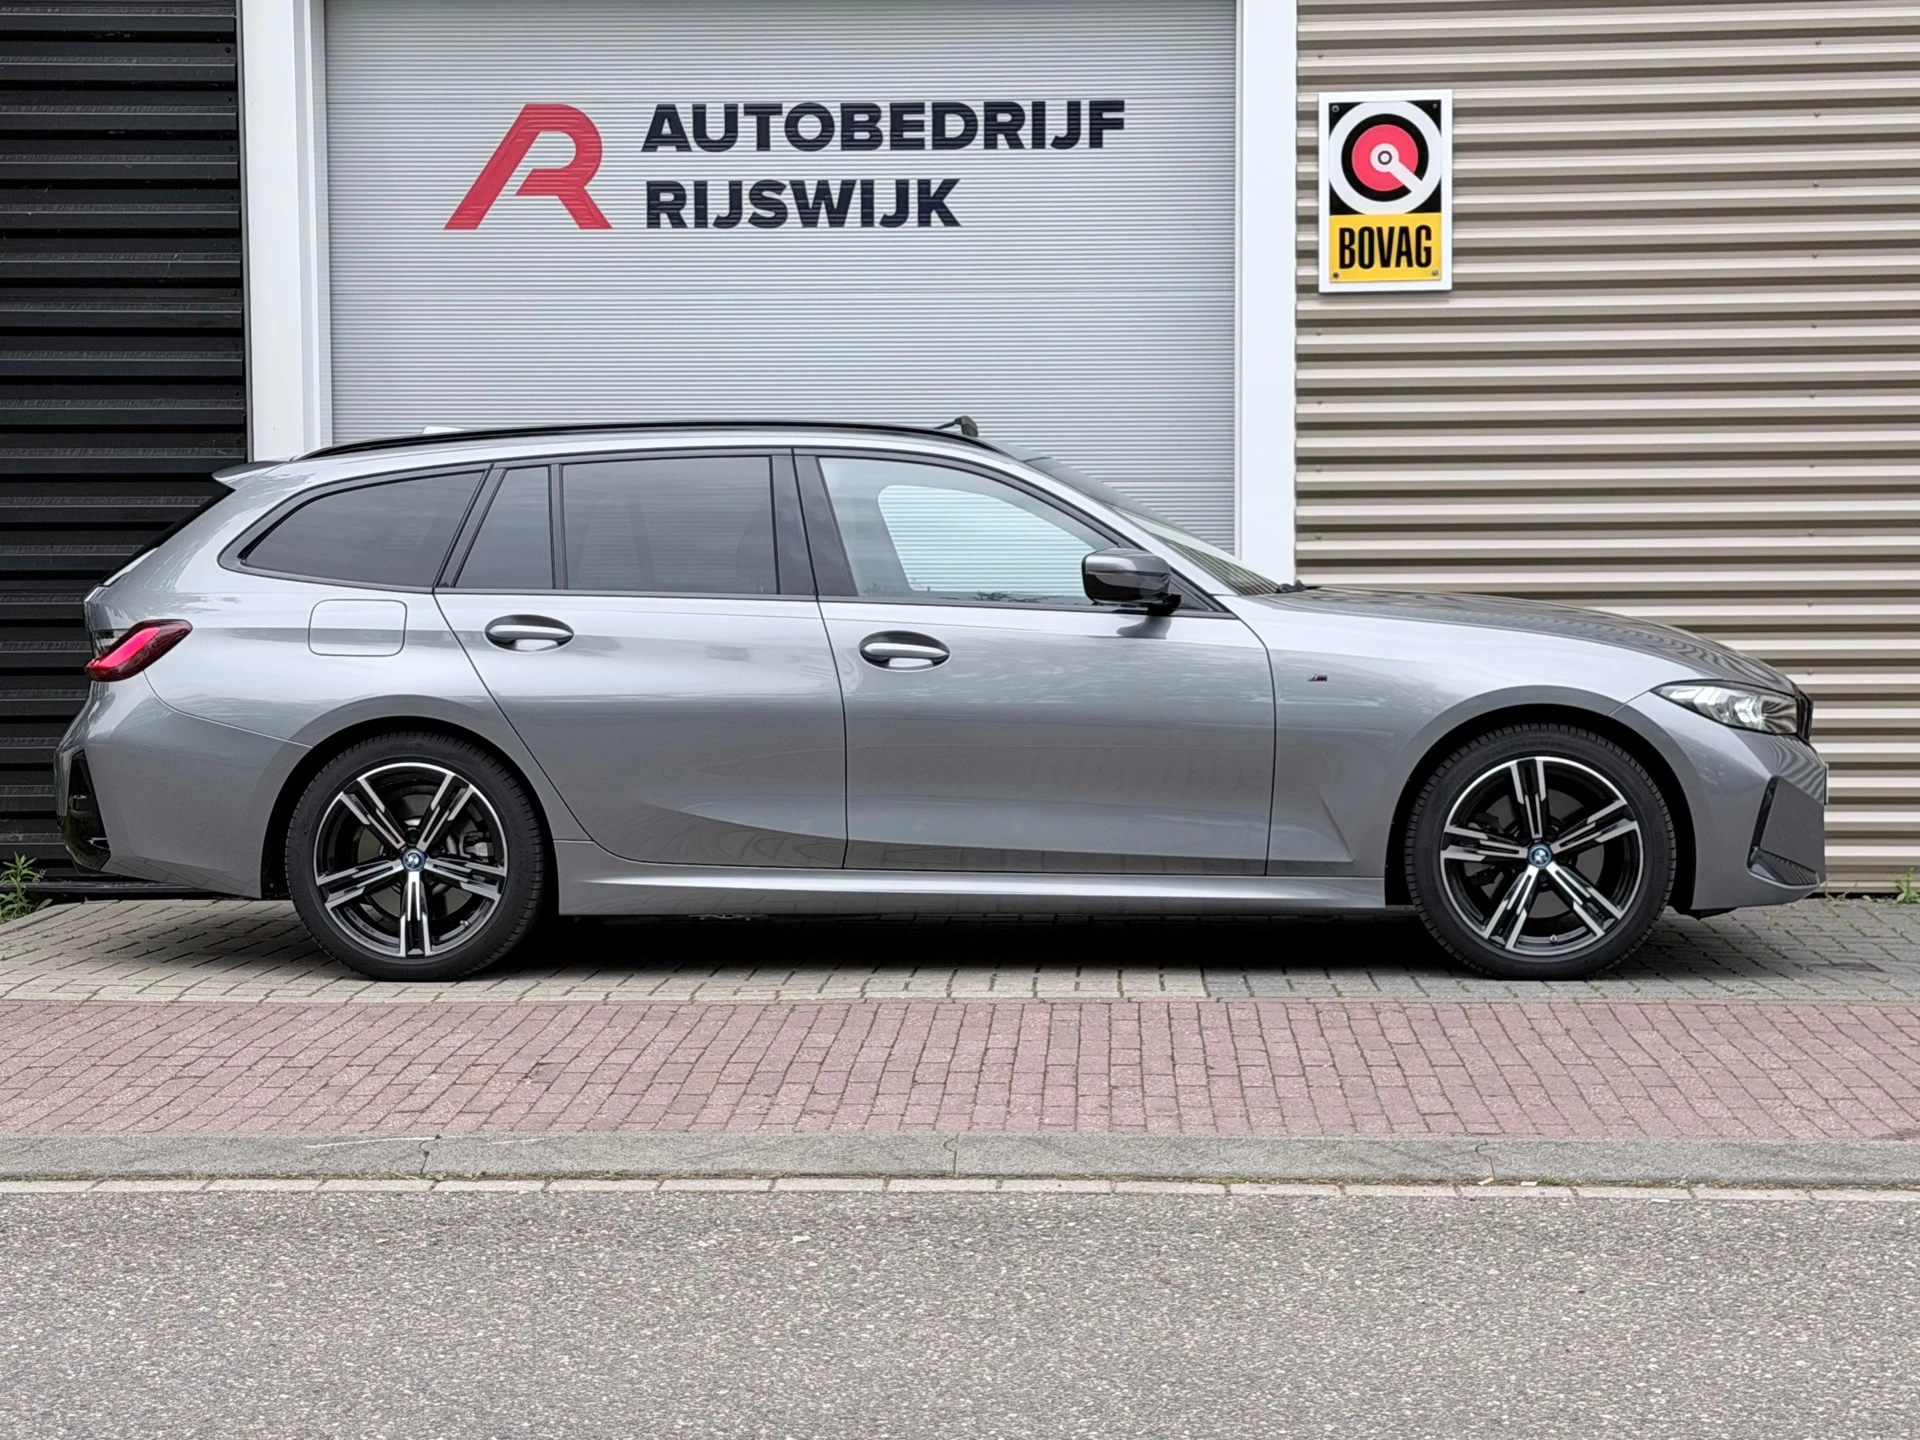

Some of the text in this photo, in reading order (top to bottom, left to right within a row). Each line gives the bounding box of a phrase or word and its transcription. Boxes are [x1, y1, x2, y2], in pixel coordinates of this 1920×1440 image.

[642, 100, 1125, 152] AUTOBEDRIJF
[646, 178, 960, 229] RIJSWIJK
[1339, 225, 1432, 269] BOVAG
